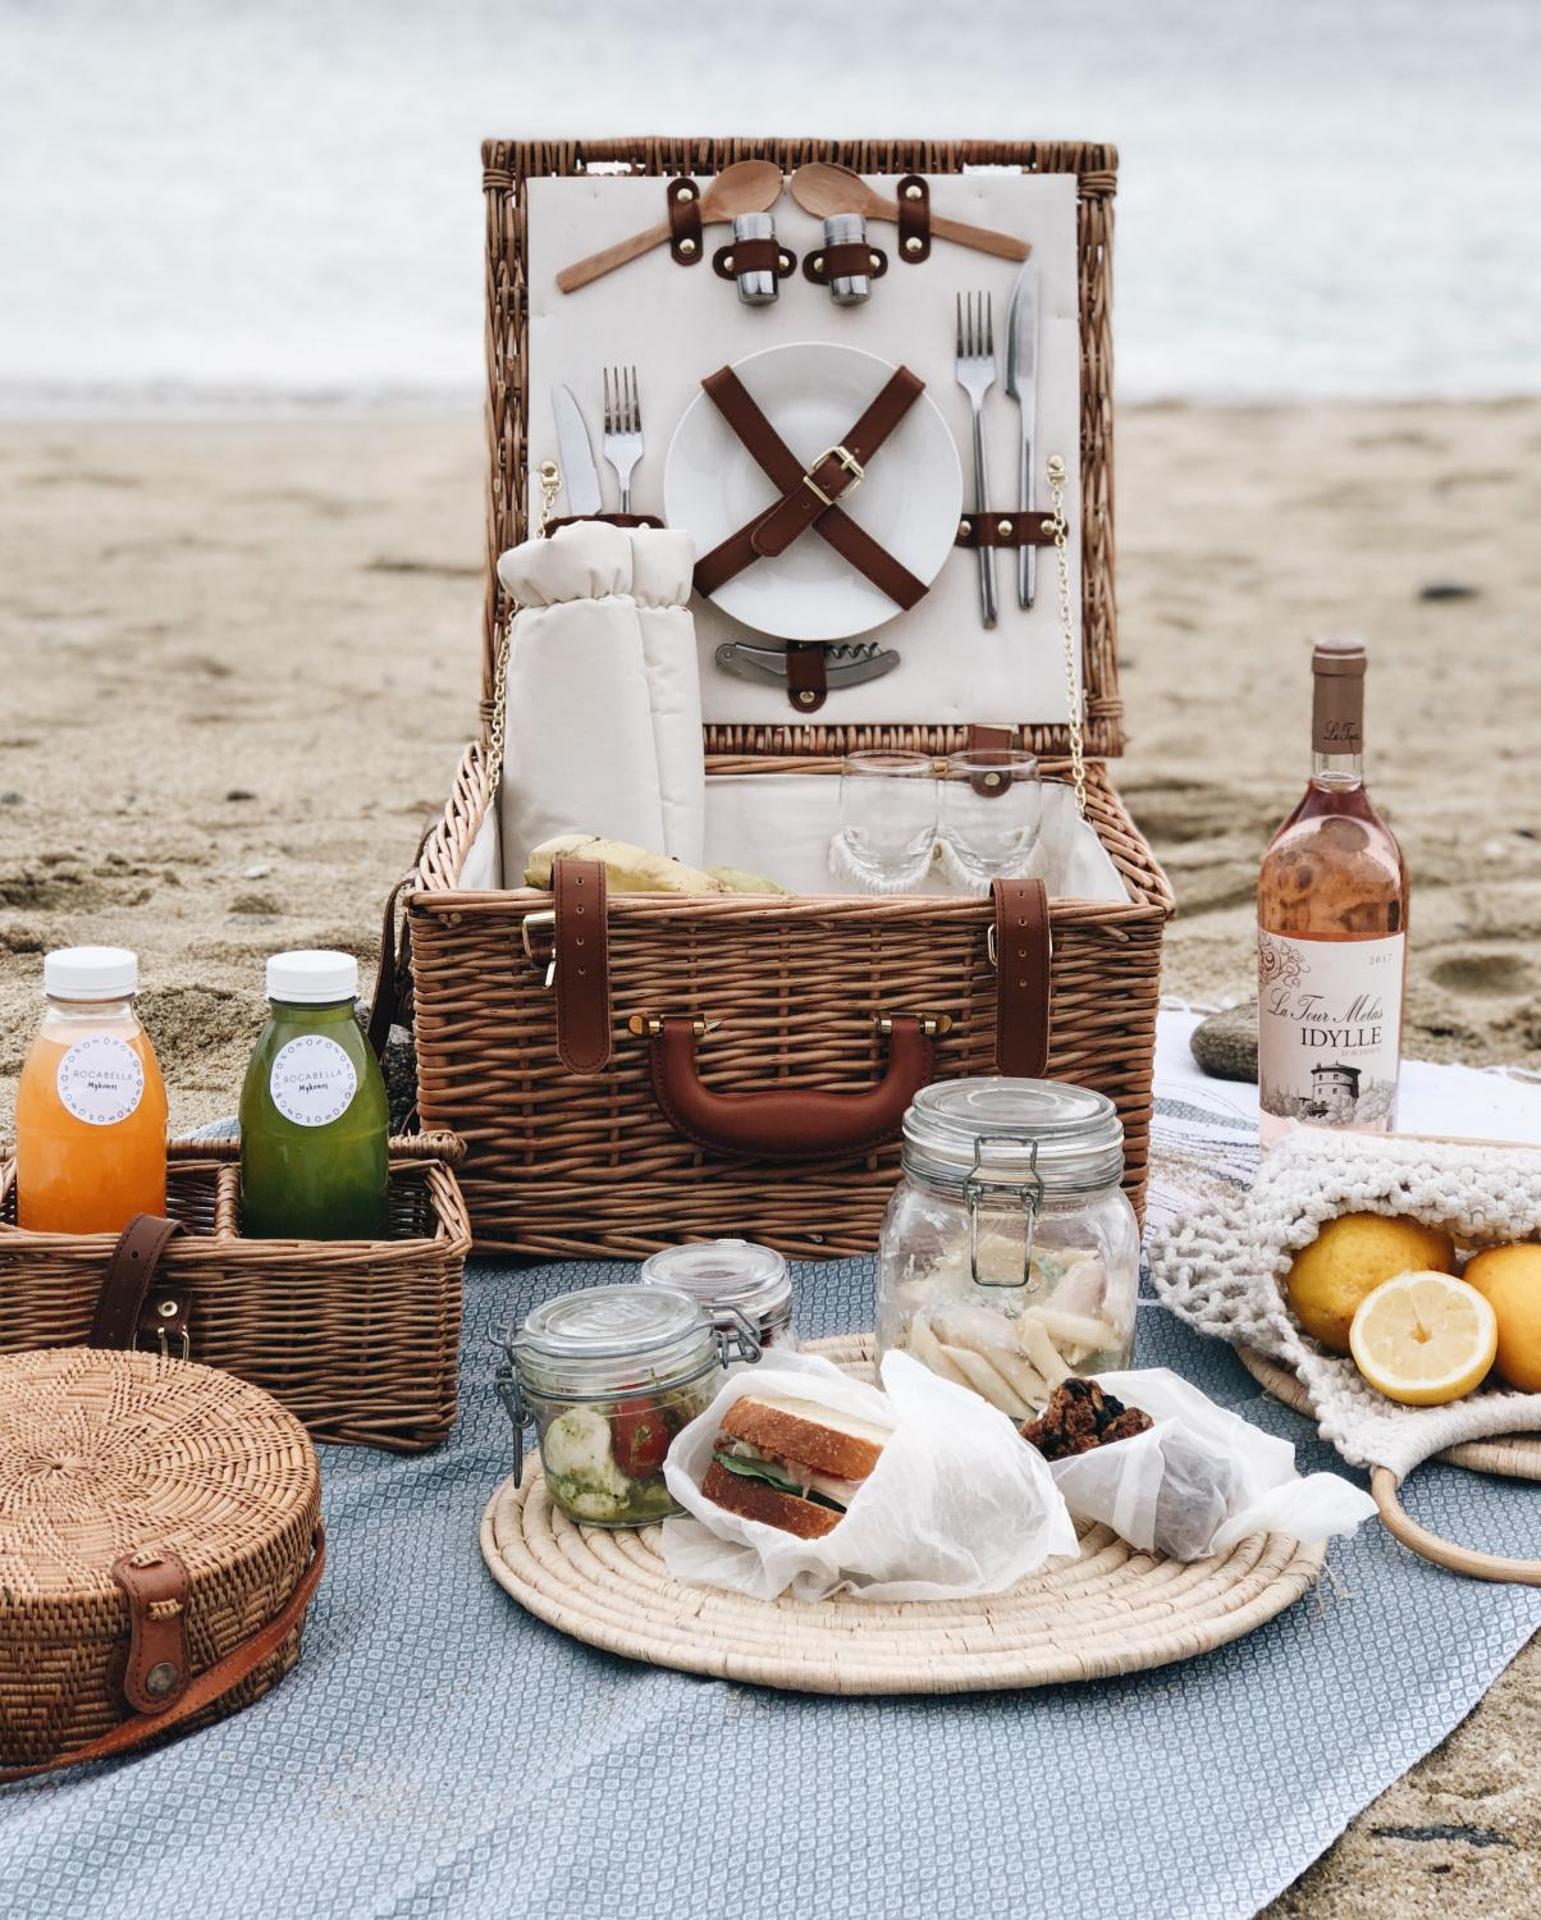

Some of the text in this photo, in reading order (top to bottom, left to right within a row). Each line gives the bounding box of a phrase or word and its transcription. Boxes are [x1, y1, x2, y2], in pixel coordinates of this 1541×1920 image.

[1368, 953, 1393, 966] 2017
[1267, 987, 1383, 1023] La Tour Melas
[1300, 1026, 1383, 1048] IDYLLE
[73, 1070, 132, 1080] ROCABELLA
[283, 1069, 342, 1083] ROCABELLA
[87, 1081, 118, 1092] Mykonos
[298, 1082, 328, 1094] Mykonos
